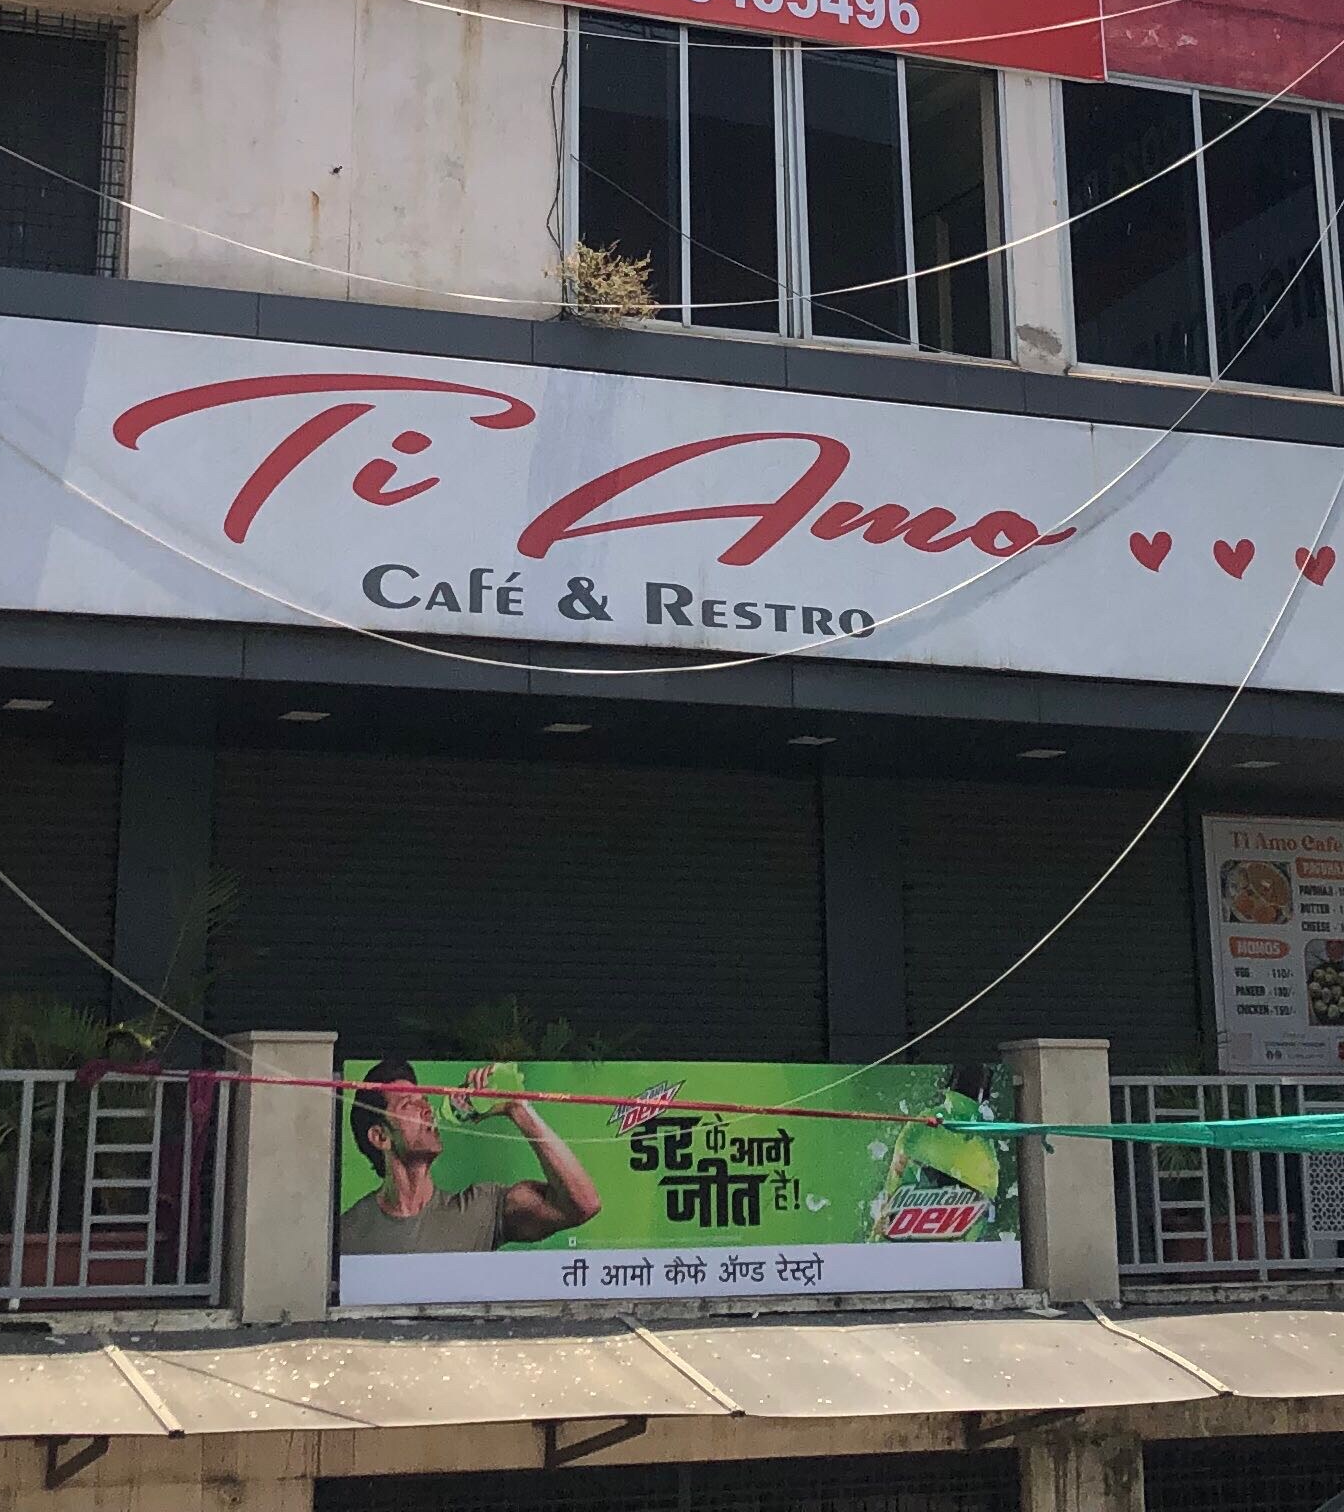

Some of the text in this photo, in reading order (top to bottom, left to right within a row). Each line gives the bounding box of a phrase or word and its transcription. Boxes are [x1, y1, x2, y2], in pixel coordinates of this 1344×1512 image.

[112, 373, 1077, 568] Ti Amo
[557, 575, 614, 622] &
[629, 1113, 795, 1172] डर के आगे
[658, 1157, 770, 1228] जीत
[560, 1257, 590, 1287] ती
[599, 1256, 654, 1287] आमो
